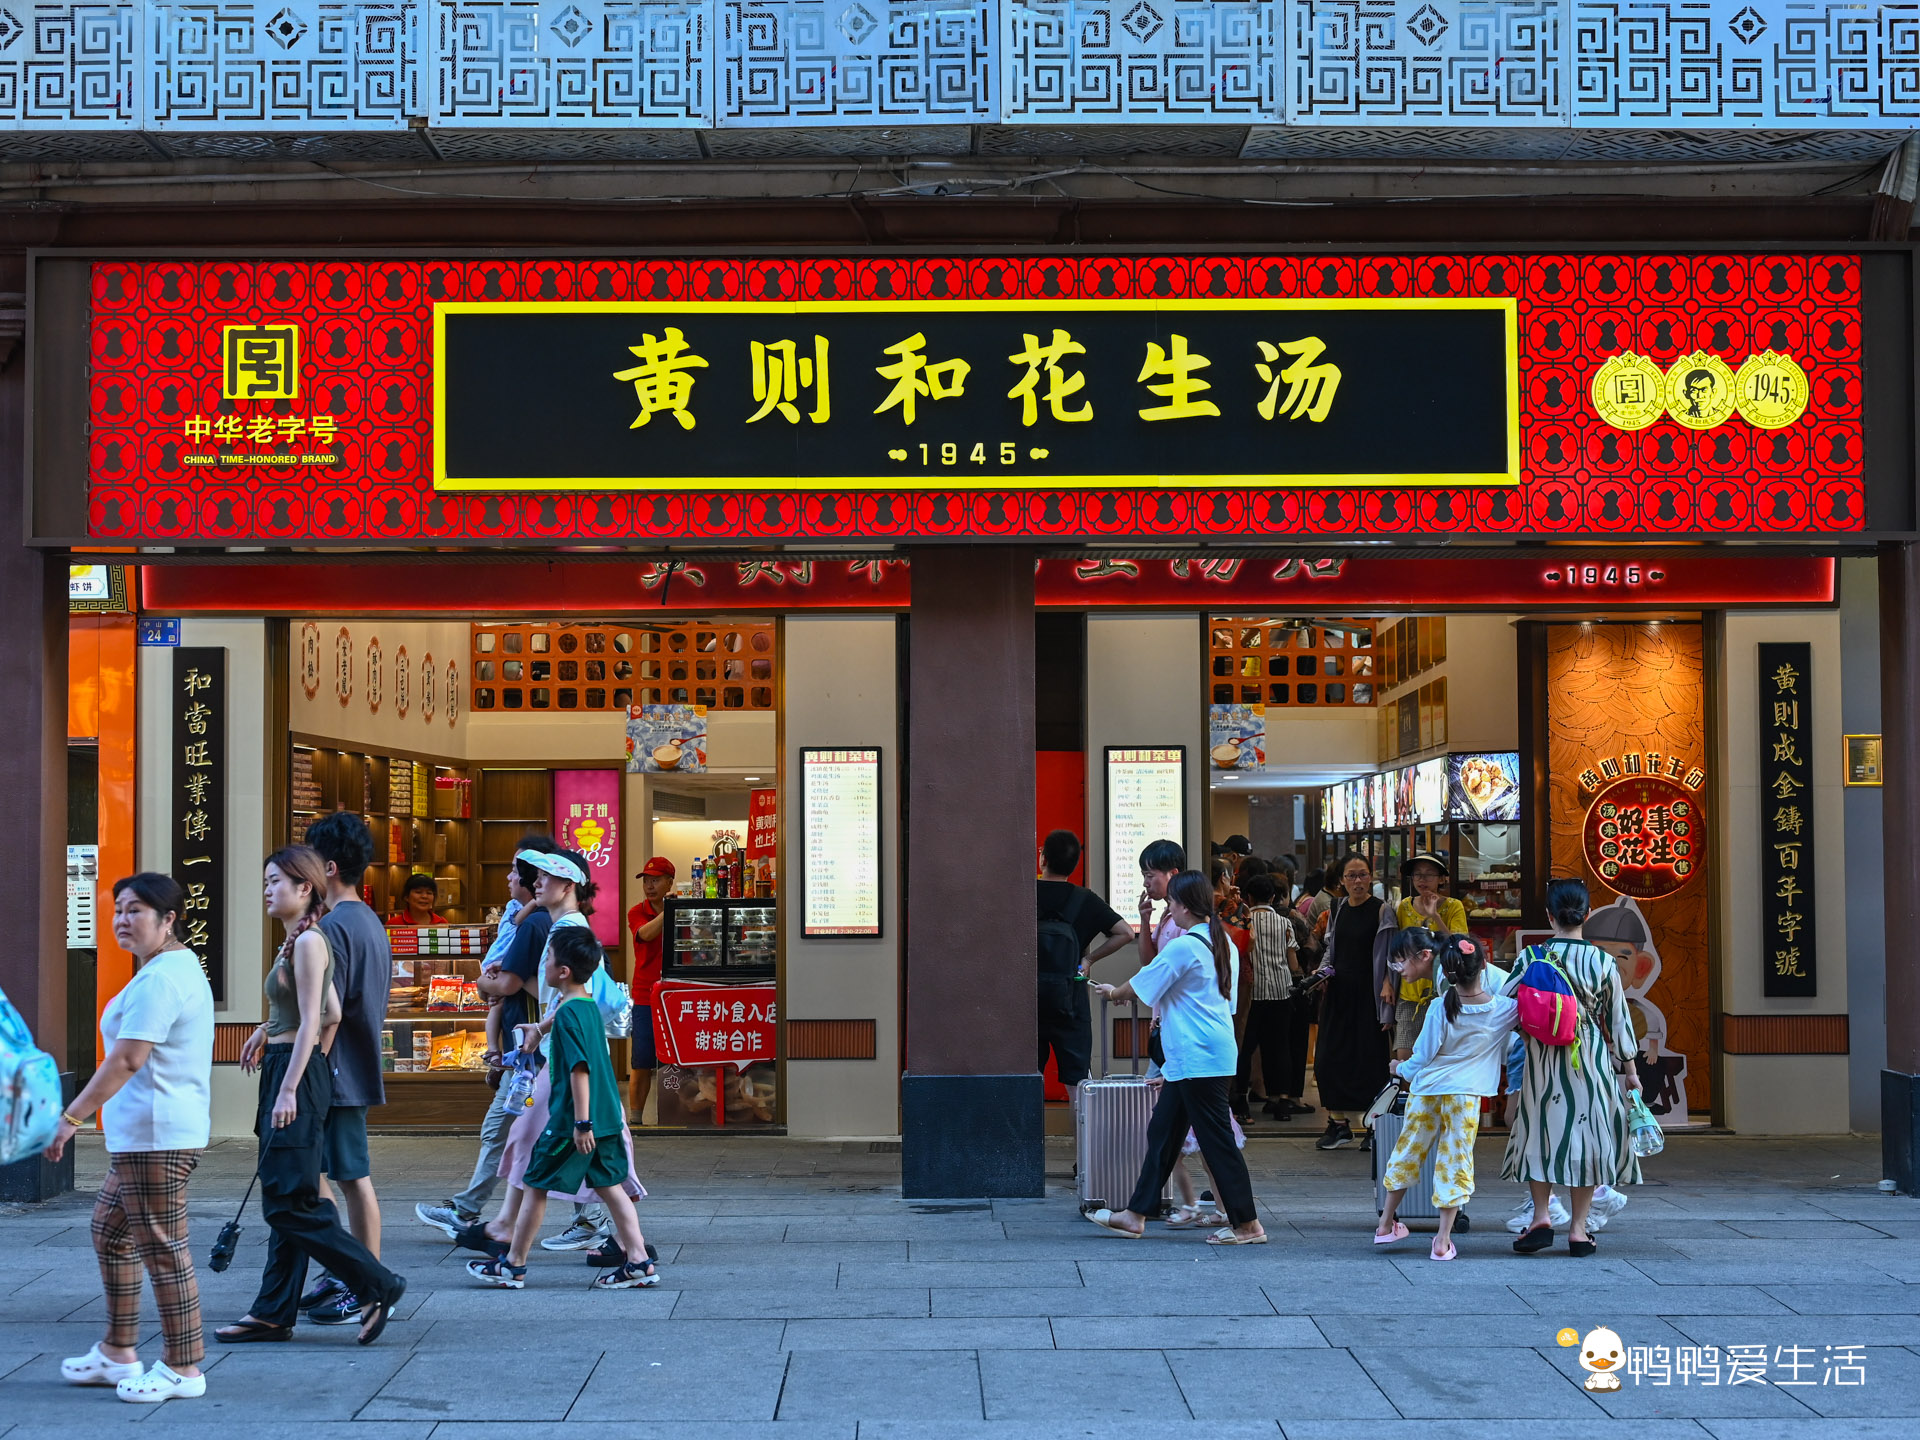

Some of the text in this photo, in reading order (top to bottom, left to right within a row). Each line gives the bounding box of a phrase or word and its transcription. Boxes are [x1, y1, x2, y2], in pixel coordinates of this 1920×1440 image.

[613, 327, 1342, 430] 黄则和花生汤
[1752, 373, 1790, 404] 1945
[184, 414, 338, 444] 中华老字号
[183, 454, 336, 464] CHINA TIME-HONORED BRAND
[919, 443, 1015, 465] 1945
[1567, 567, 1640, 584] 1945
[147, 629, 161, 642] 24
[182, 667, 213, 981] 和當旺業傳一品名
[570, 803, 608, 818] 椰子饼
[1617, 805, 1674, 835] 好事
[1602, 805, 1617, 875] 汤来运转
[1617, 836, 1676, 866] 花生
[1673, 803, 1690, 873] 老号有售
[679, 1000, 776, 1023] 严禁外食入店
[695, 1029, 763, 1052] 谢谢合作
